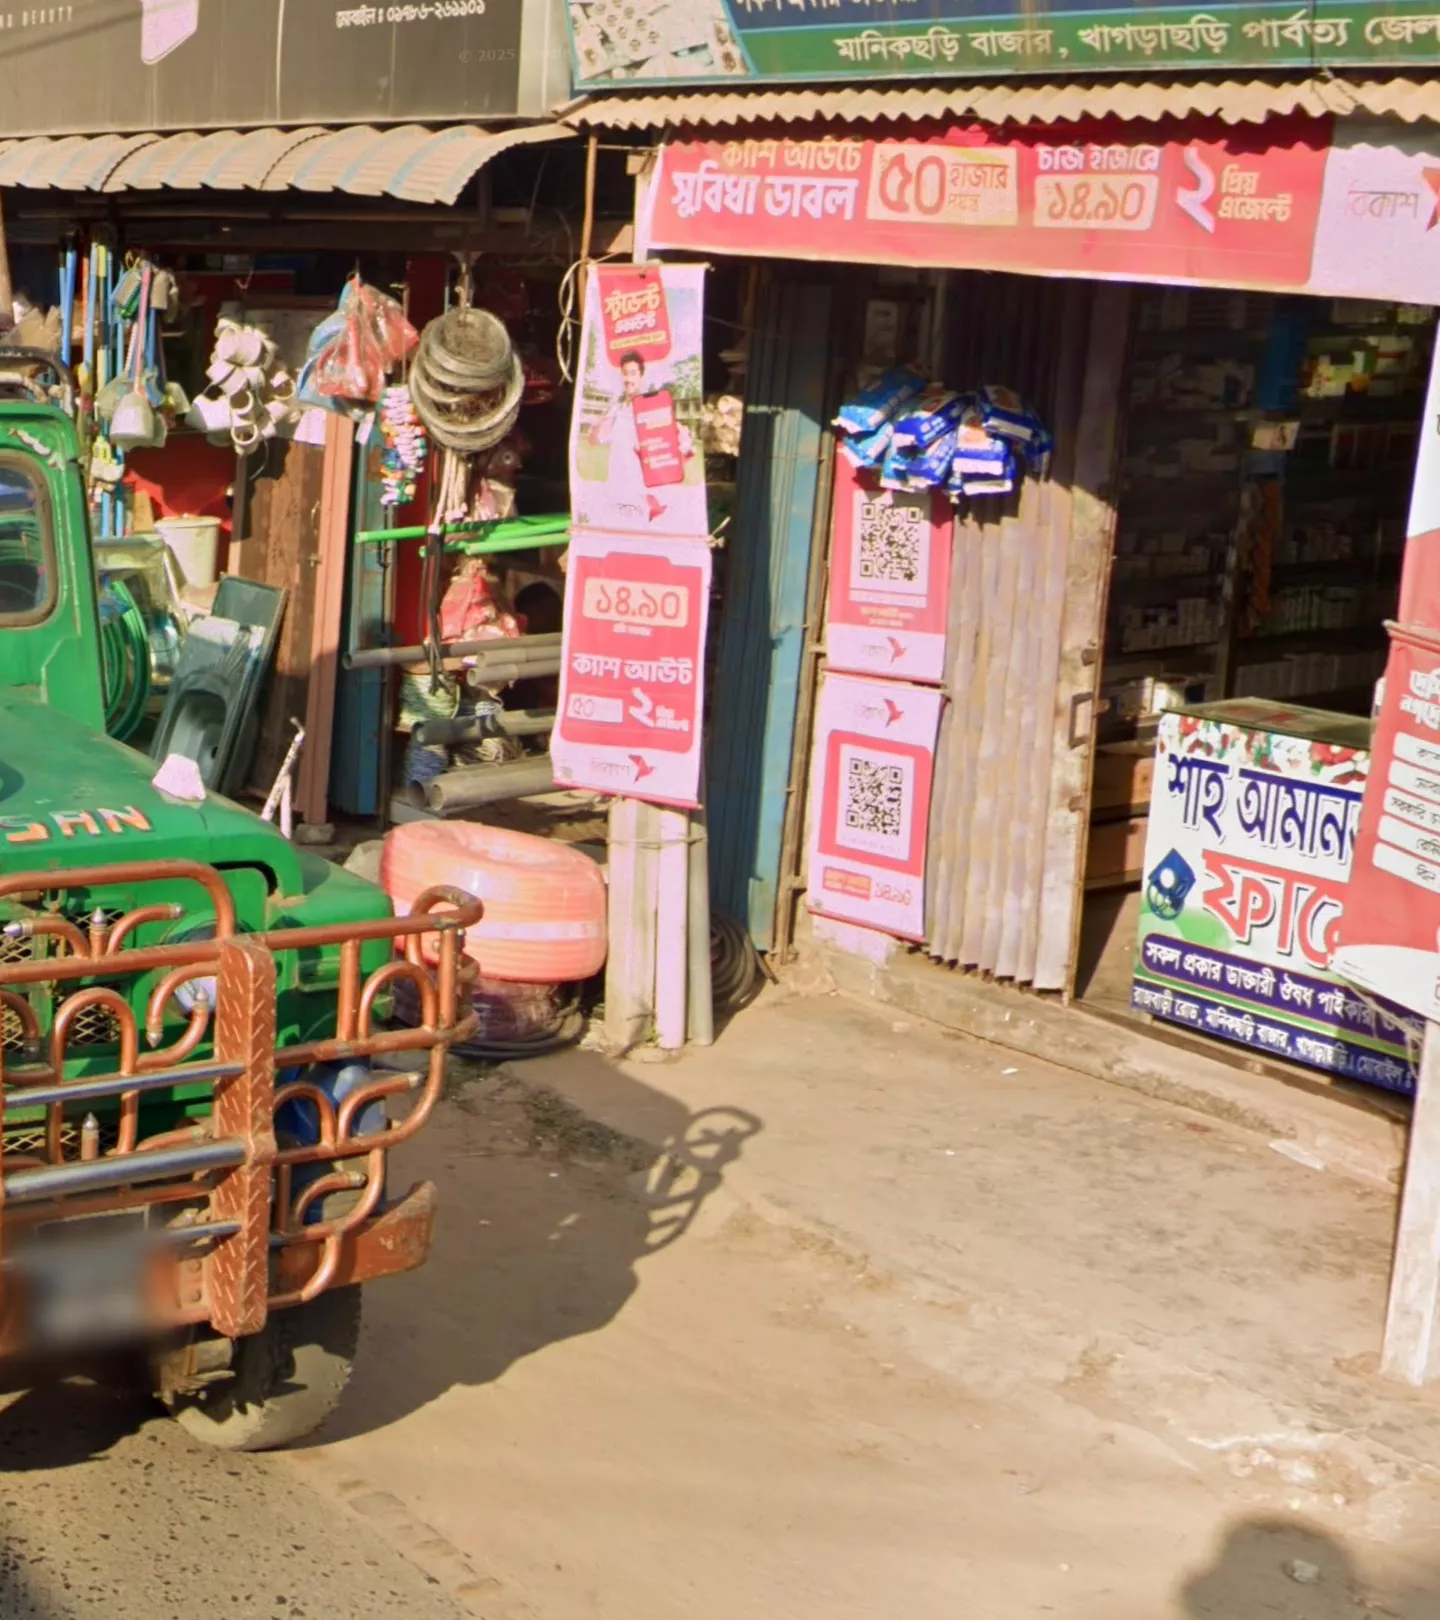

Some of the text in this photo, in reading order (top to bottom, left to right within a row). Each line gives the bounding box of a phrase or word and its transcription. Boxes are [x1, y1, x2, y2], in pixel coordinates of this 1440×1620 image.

[833, 26, 960, 61] মানিকছড়ি
[1078, 13, 1232, 54] খাগড়াছড়ি
[672, 160, 860, 221] সুবিধা ডাবল
[879, 152, 948, 216] ৫০
[949, 162, 1009, 190] হাজার
[1177, 147, 1216, 233] ২
[1047, 180, 1145, 222] ১৪.৯০
[595, 584, 681, 620] ১৪.৯০
[572, 652, 694, 686] ক্যাশ আউট
[1168, 754, 1363, 861] শাহ আমান
[1145, 941, 1183, 971] সকল
[1183, 953, 1224, 983] প্রকার
